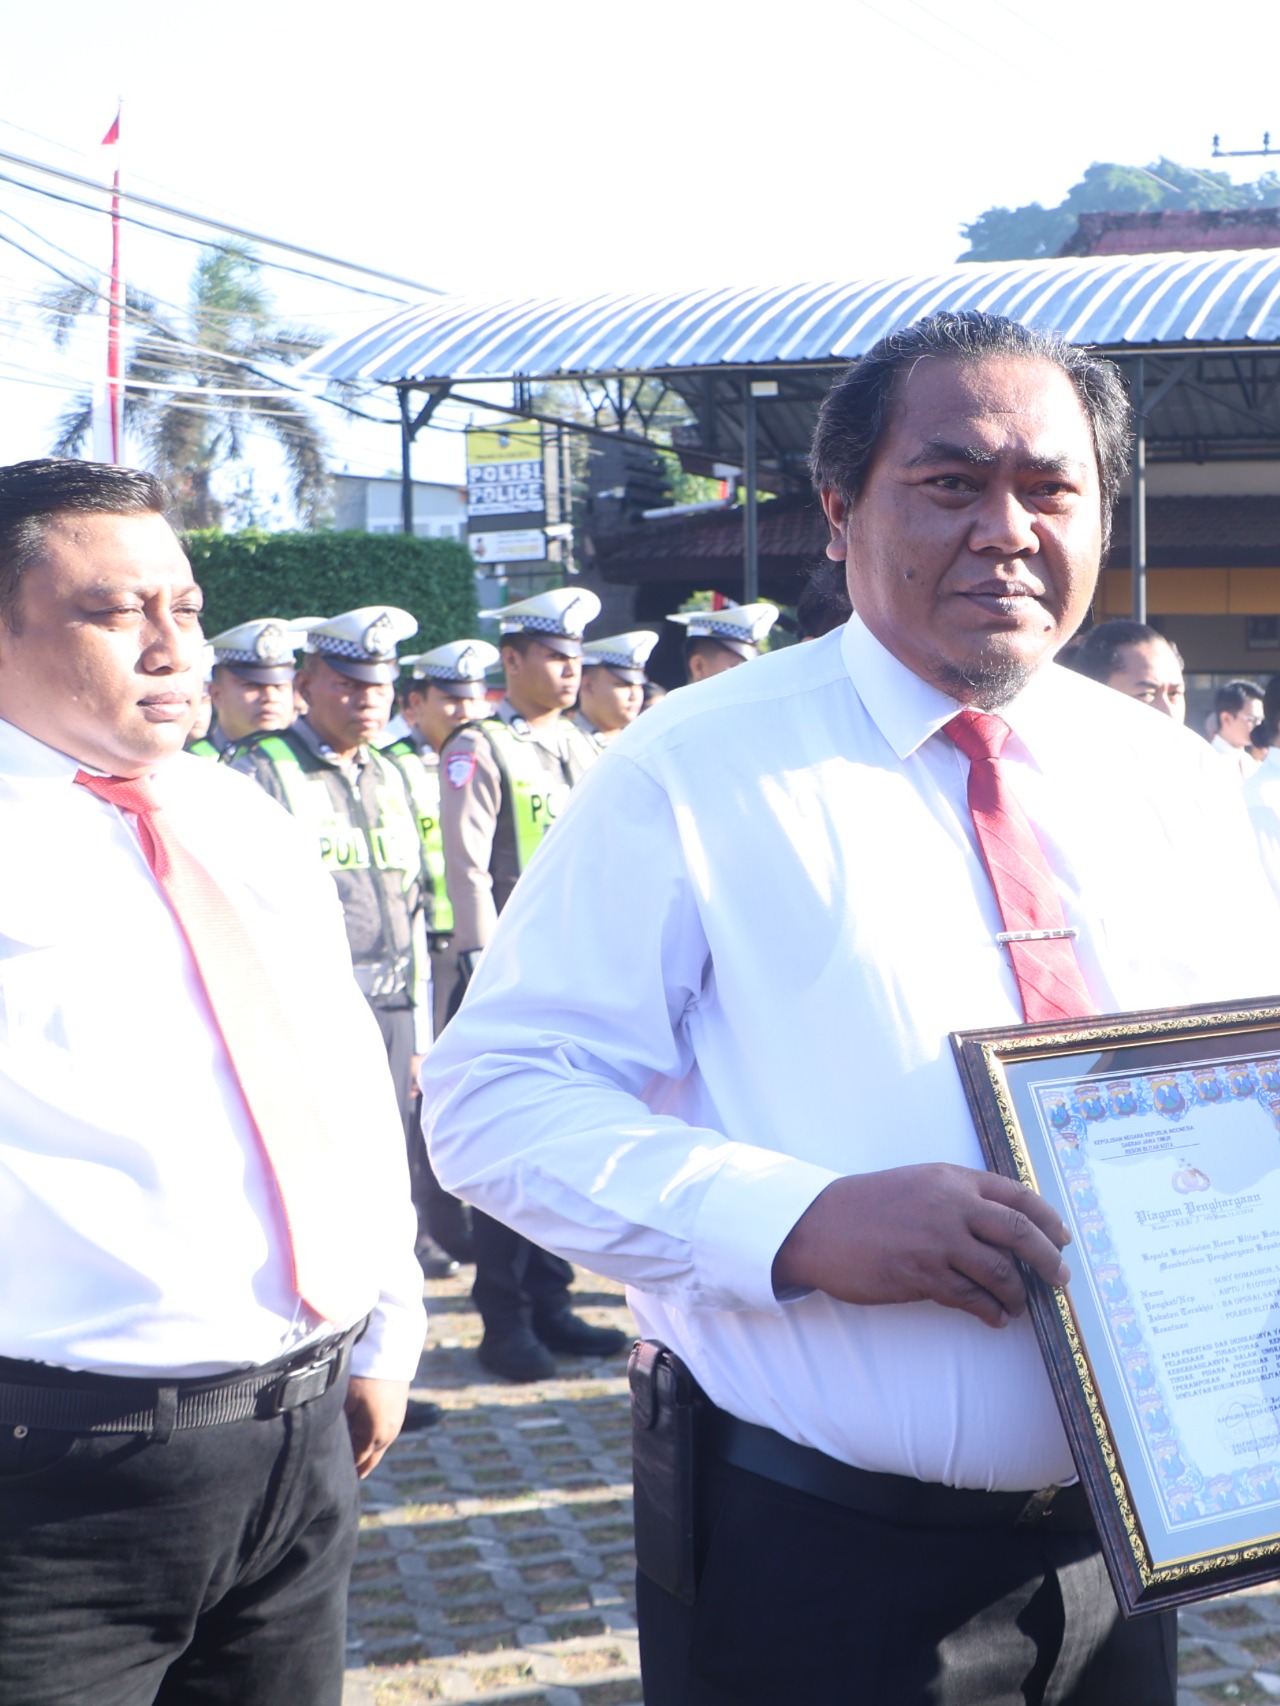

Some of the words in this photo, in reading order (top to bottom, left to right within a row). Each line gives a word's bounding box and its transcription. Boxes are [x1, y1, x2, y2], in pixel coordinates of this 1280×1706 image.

[469, 462, 542, 483] POLISI
[469, 483, 542, 504] POLICE
[1092, 1135, 1123, 1145] KEPOLISIAN
[1122, 1132, 1143, 1141] NEGARA
[1143, 1129, 1168, 1137] REPUBLIK
[1167, 1125, 1195, 1134] INDONESIA
[1120, 1139, 1142, 1148] DAERAH
[1124, 1146, 1142, 1154] RESOR
[1133, 1203, 1184, 1226] Piagam
[1183, 1190, 1263, 1217] Penghargaan
[1252, 1301, 1280, 1313] BLITAR
